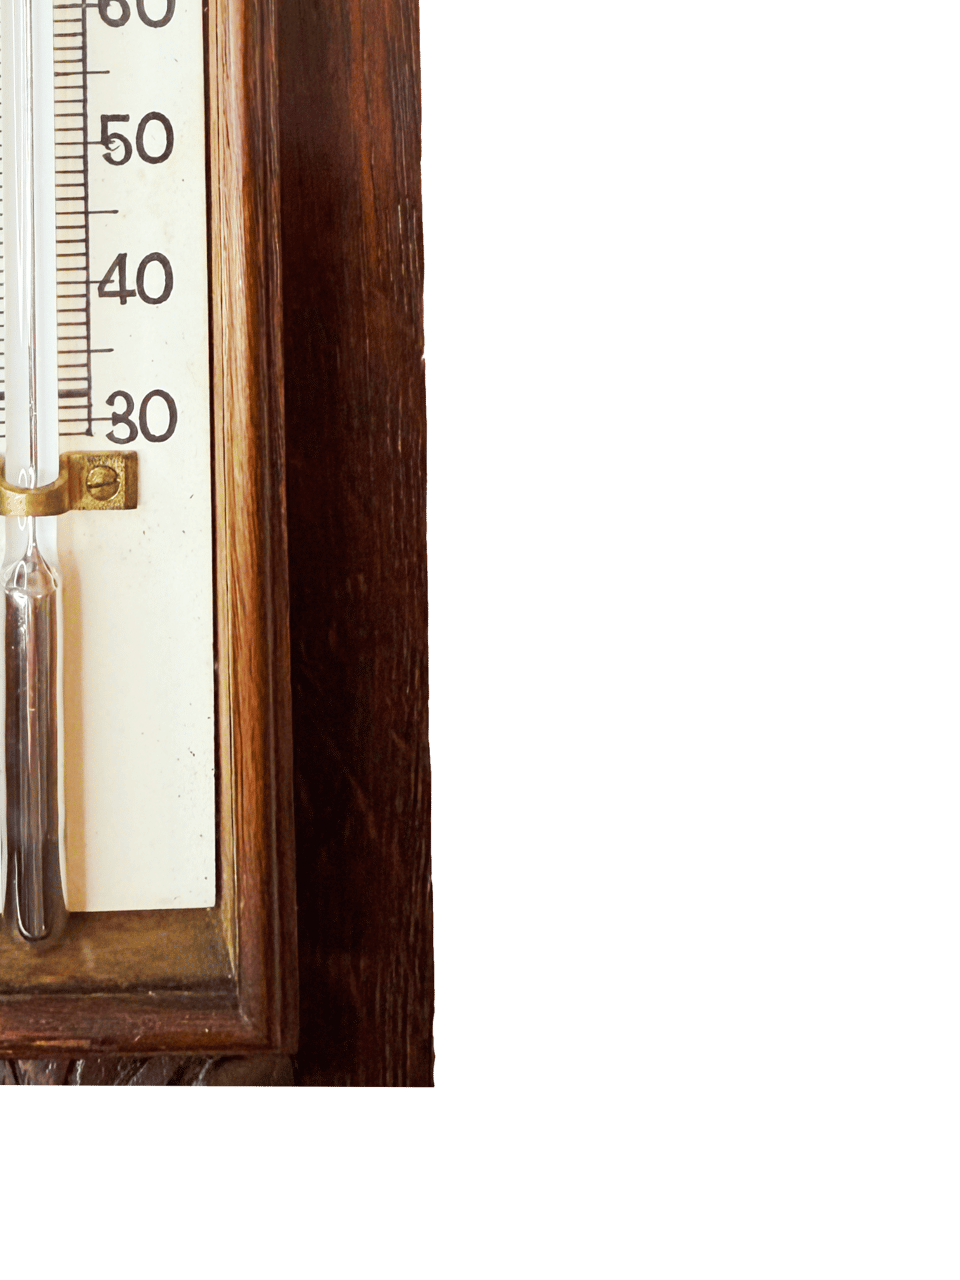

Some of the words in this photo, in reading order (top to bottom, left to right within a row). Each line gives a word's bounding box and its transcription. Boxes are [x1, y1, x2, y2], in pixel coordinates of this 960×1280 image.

[100, 111, 174, 166] 50
[98, 252, 174, 305] 40
[105, 389, 178, 444] 30
